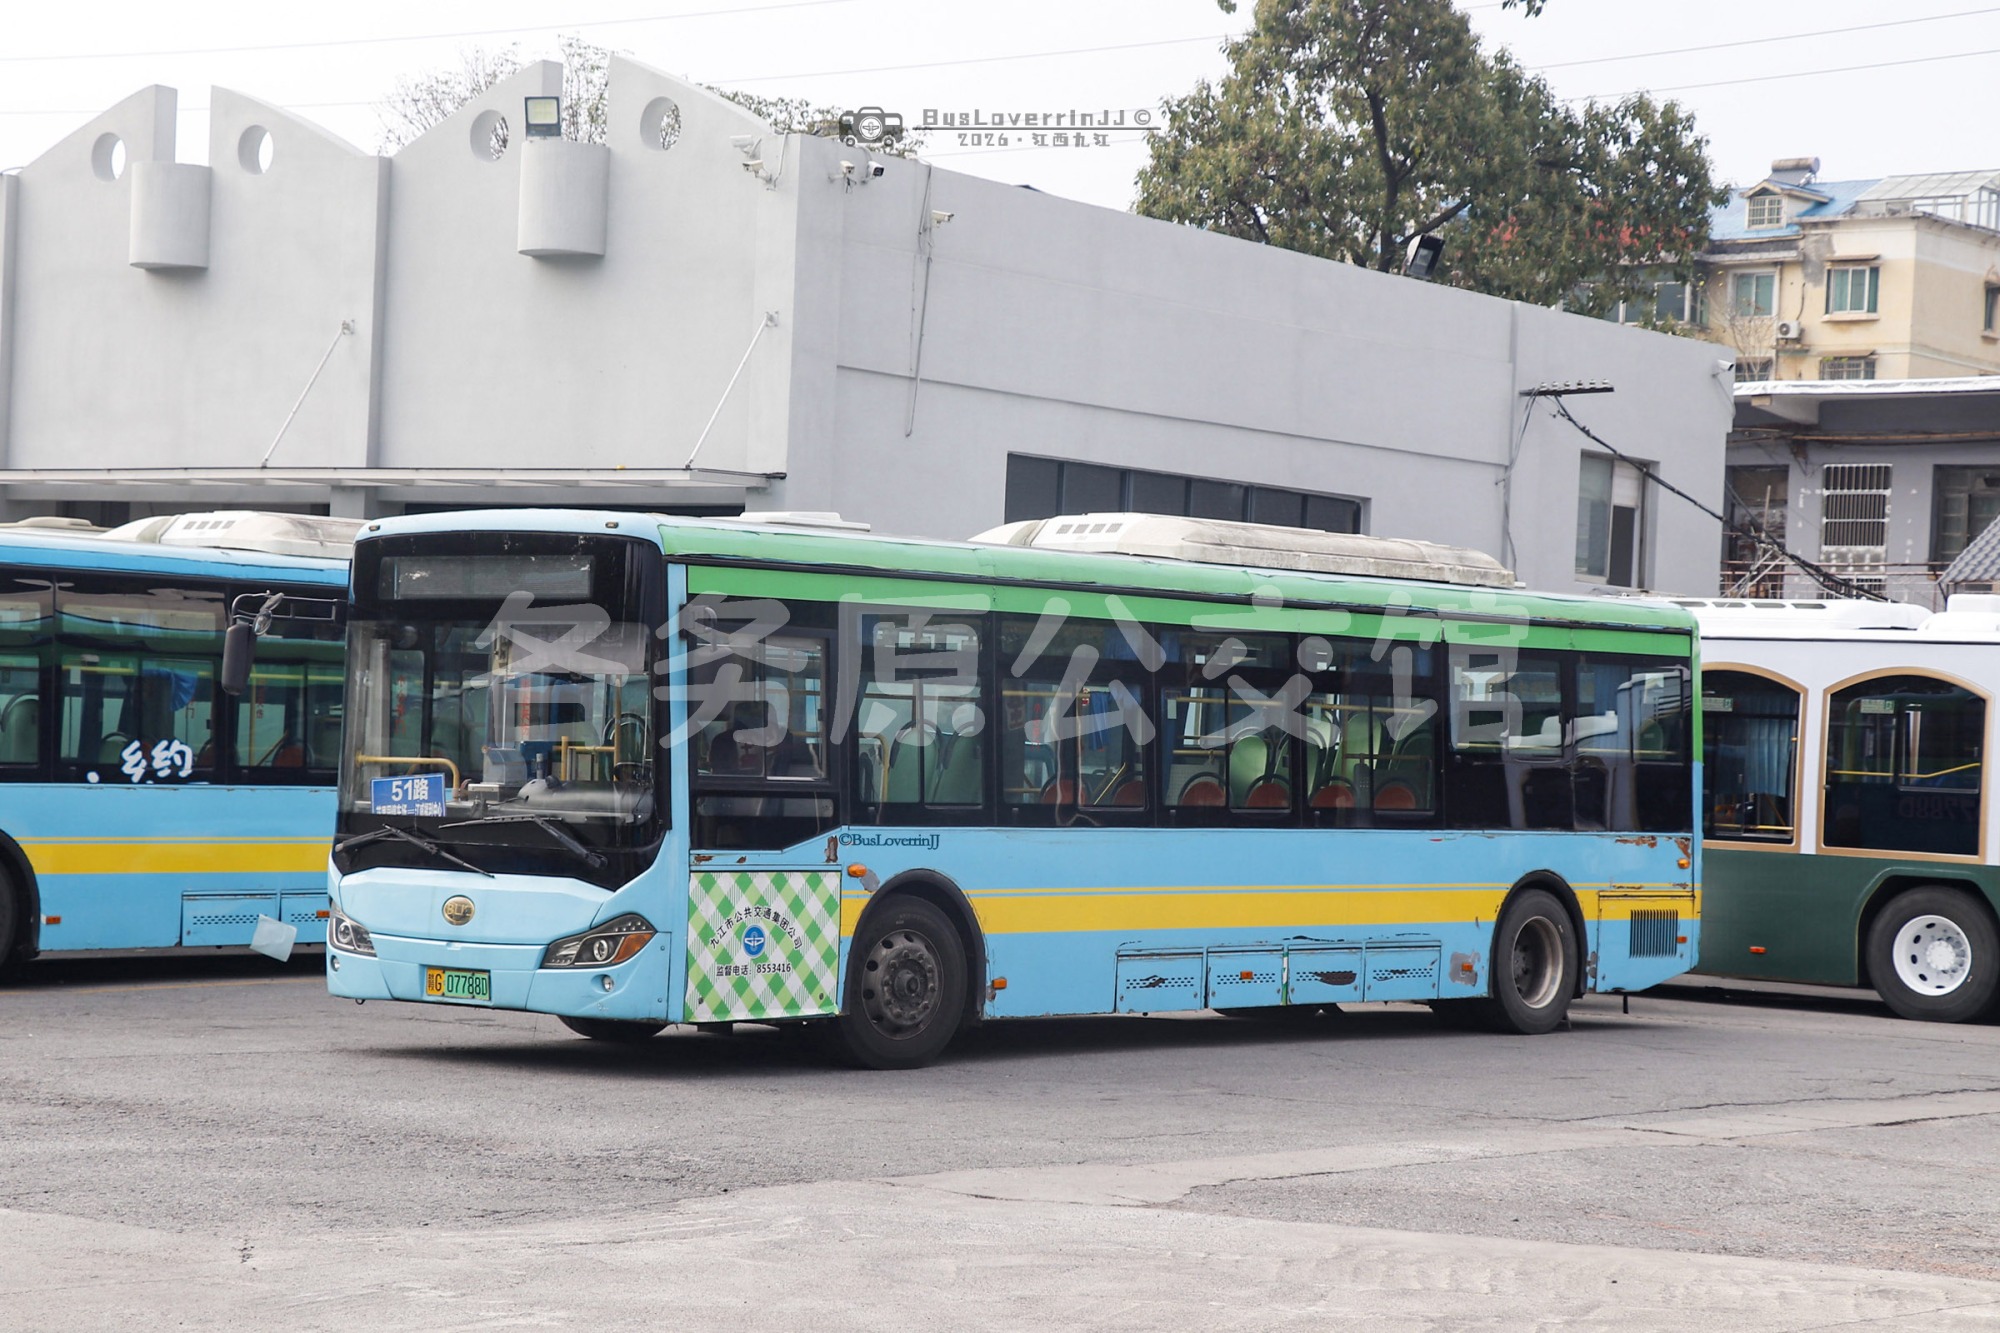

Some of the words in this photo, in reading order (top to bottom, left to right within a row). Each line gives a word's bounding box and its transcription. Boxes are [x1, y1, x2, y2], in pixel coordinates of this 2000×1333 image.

[391, 778, 429, 802] 51路
[709, 906, 803, 950] 九江市公共交通集团公司
[756, 963, 792, 974] 8553416
